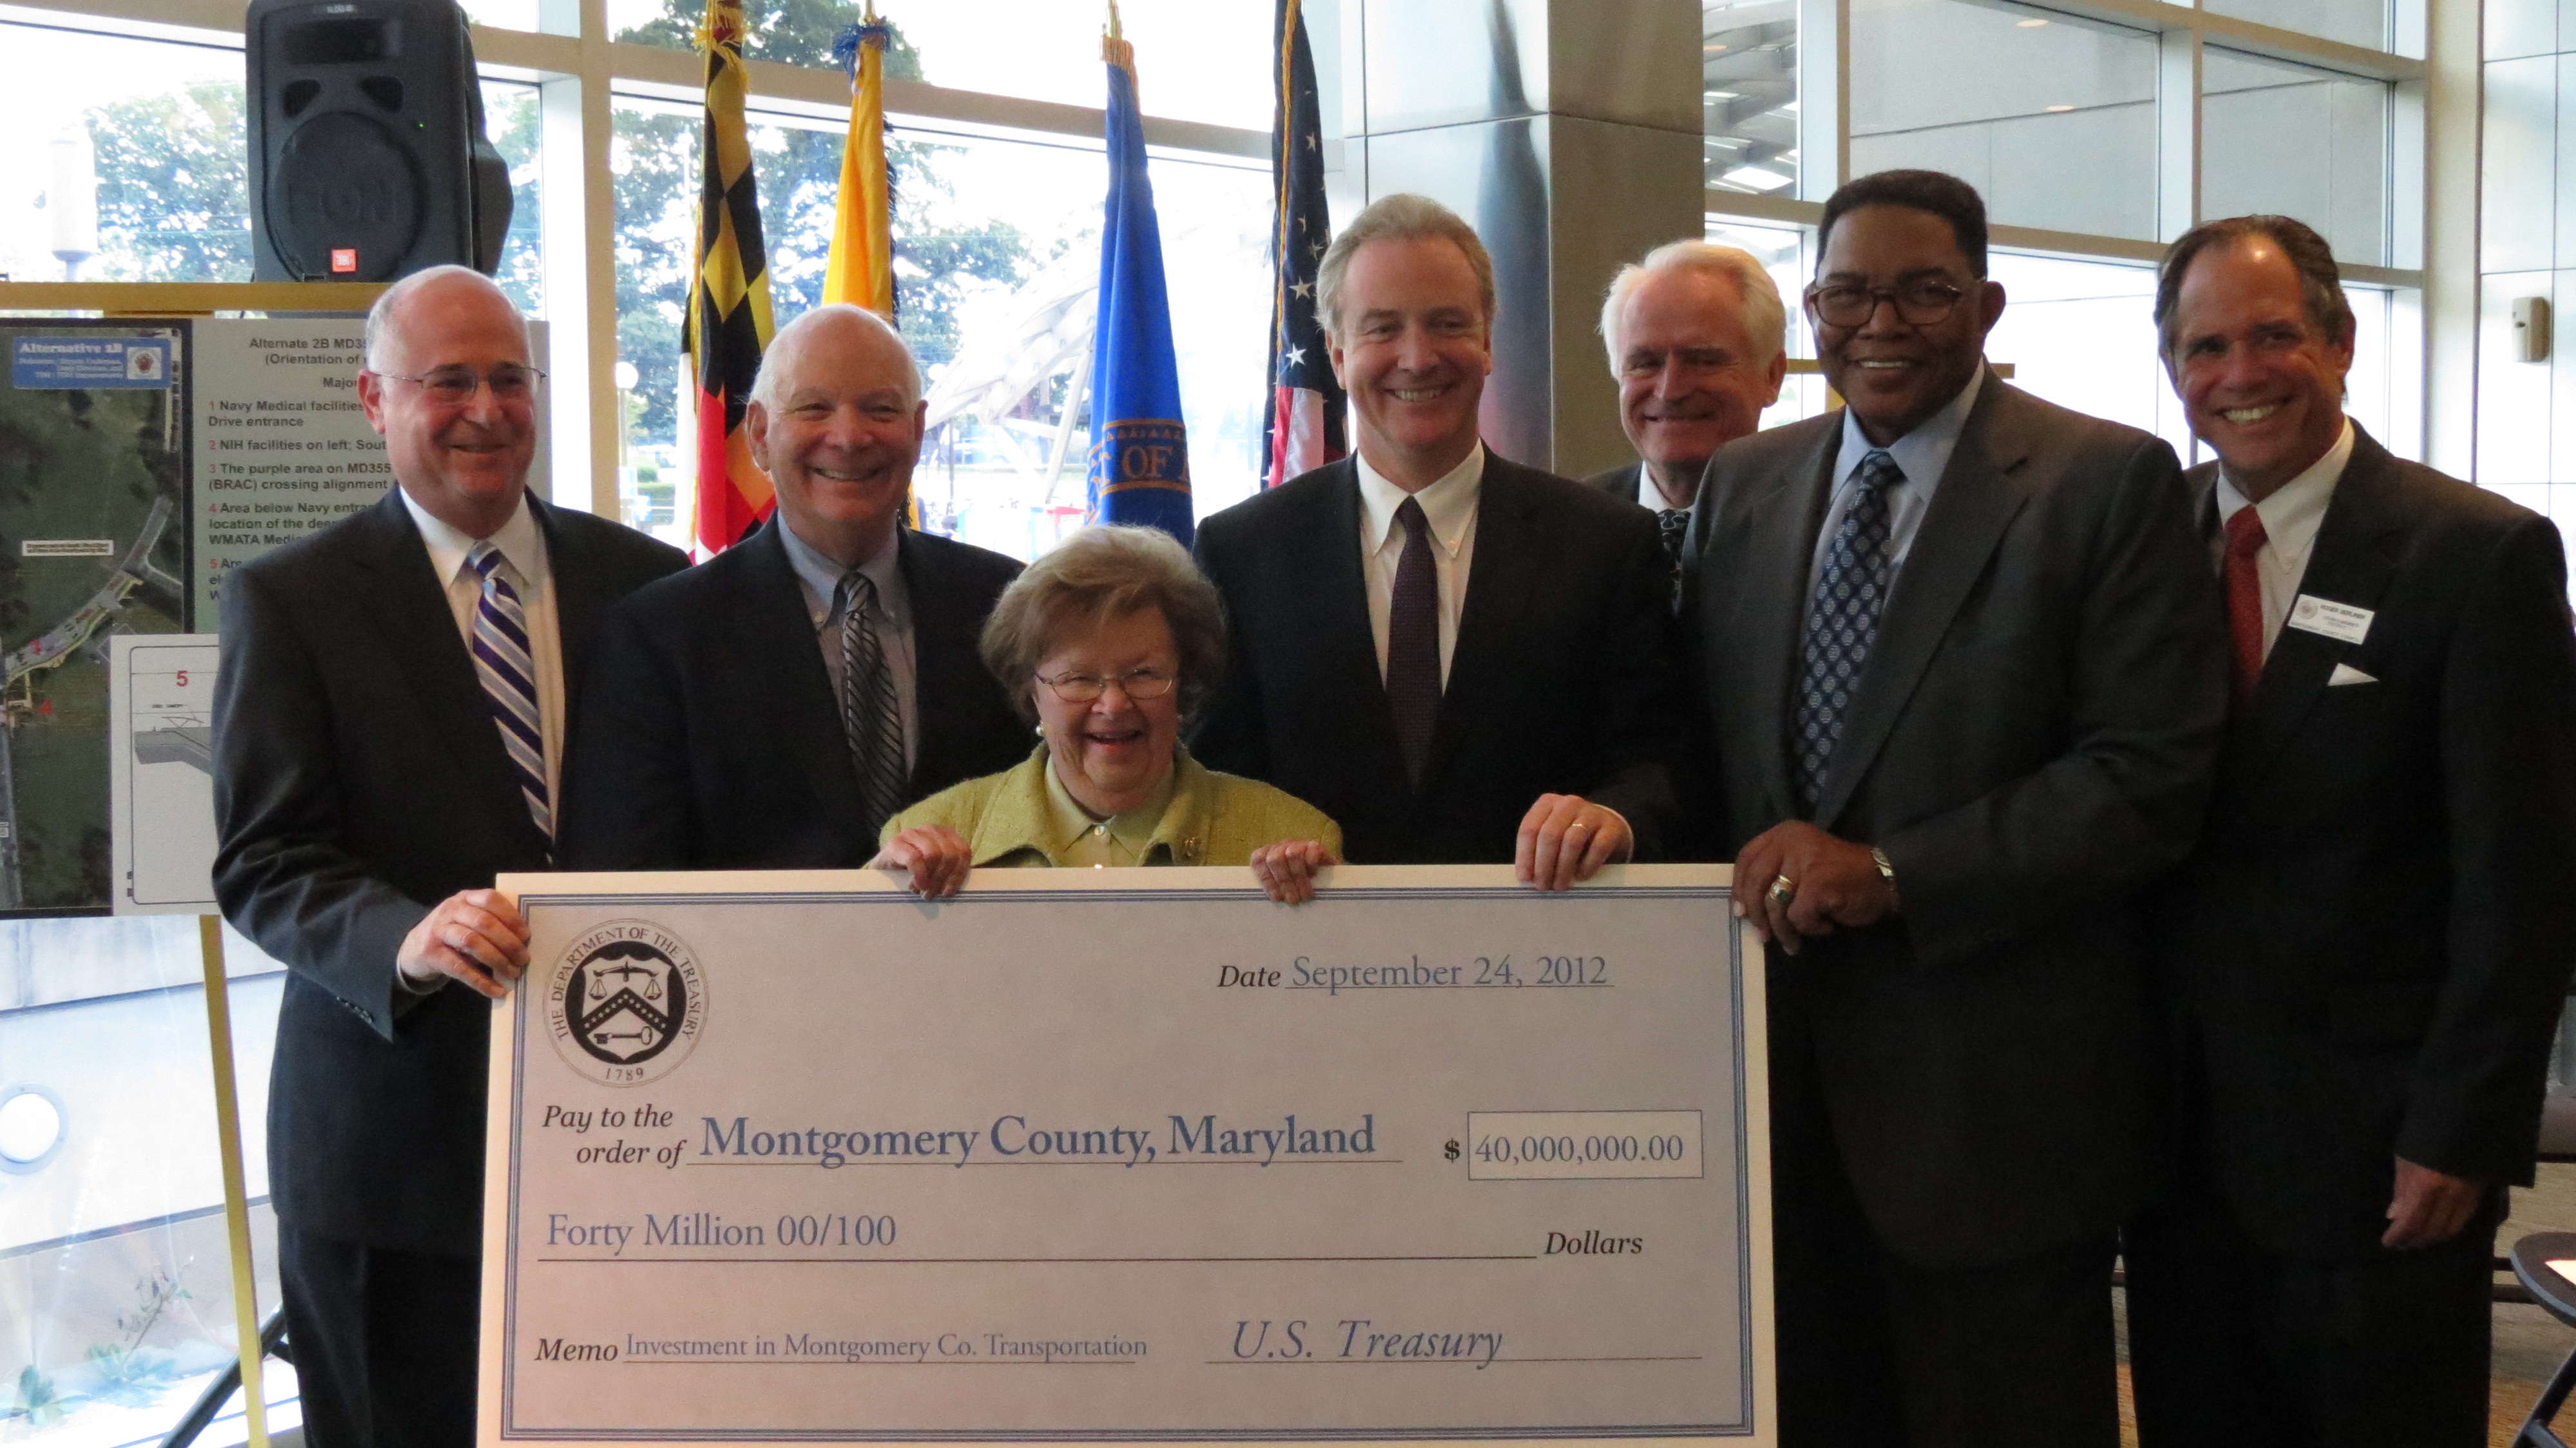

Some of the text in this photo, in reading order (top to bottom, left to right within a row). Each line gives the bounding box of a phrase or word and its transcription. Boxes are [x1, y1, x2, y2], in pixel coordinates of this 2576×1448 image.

[250, 338, 308, 348] Alternate
[312, 338, 330, 348] 2B
[265, 354, 343, 365] (Orientation
[346, 354, 360, 365] of
[208, 400, 363, 413] 1 Navy Medical facilities
[209, 416, 303, 427] Drive entrance
[209, 441, 216, 450] 2
[220, 439, 243, 450] NIH
[247, 439, 303, 450] facilities
[307, 442, 322, 450] on
[1122, 444, 1173, 479] OF
[209, 462, 391, 476] 3 The purple area on MD355
[209, 478, 388, 491] (BRAC) crossing alignment
[209, 503, 217, 513] 4
[220, 502, 250, 513] Area
[255, 502, 294, 513] below
[298, 502, 330, 515] Navy
[209, 518, 262, 529] location
[266, 518, 279, 529] of
[283, 518, 303, 529] the
[209, 533, 260, 545] WMATA
[210, 558, 218, 569] 5
[176, 670, 189, 687] 5
[1217, 954, 1607, 996] Date September 24, 2012
[551, 926, 701, 1041] THE DEPARTMENT OF THE TREASURY
[605, 1067, 644, 1081] 1789
[542, 1103, 674, 1133] Pay to the
[576, 1114, 1683, 1169] order of Montgomery County, Maryland $ 40,000,000.00
[546, 1213, 896, 1256] Forty Million 00/100
[1544, 1230, 1643, 1255] Dollars
[533, 1333, 1148, 1363] Memo Investment in Montgomery Co. Transportation
[1233, 1319, 1504, 1370] U.S. Treasury
